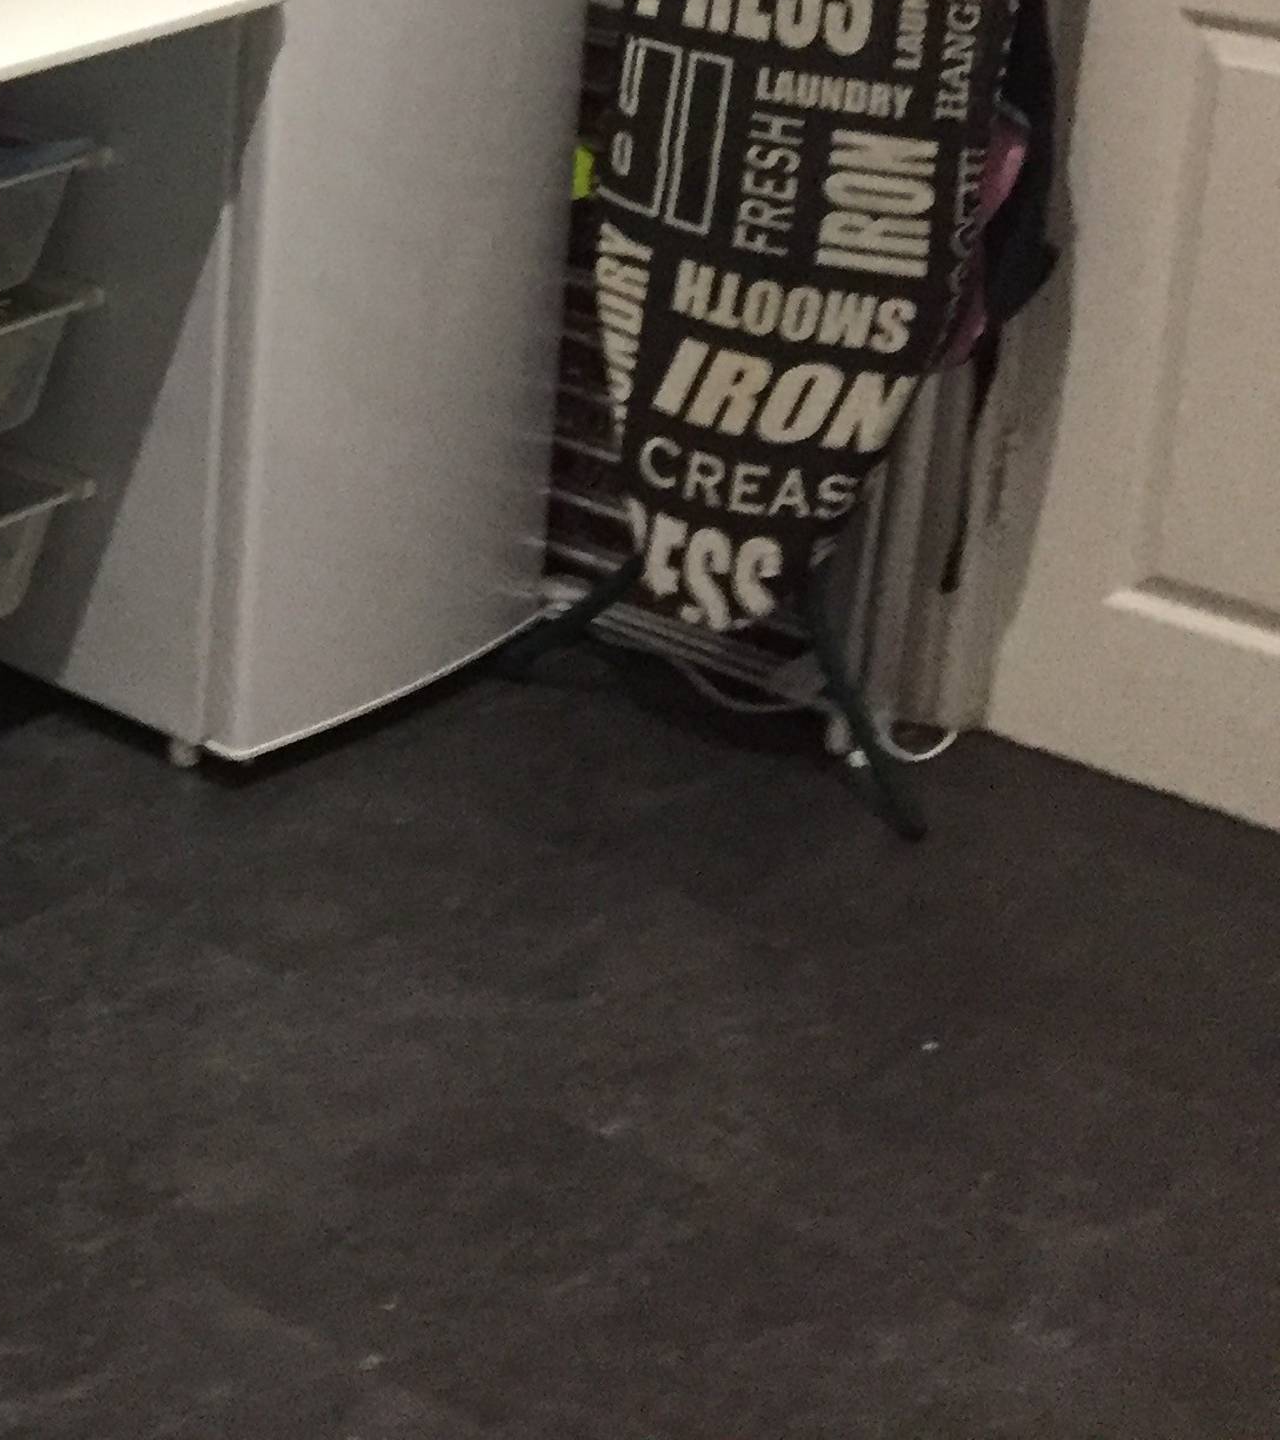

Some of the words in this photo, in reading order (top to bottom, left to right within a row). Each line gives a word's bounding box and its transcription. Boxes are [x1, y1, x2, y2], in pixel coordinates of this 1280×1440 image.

[756, 66, 914, 120] LAUNDRY
[733, 111, 806, 257] FRESH
[815, 128, 940, 278] IRON
[595, 221, 654, 432] UNDRY
[671, 258, 917, 353] SMOOTH
[651, 337, 919, 453] IRON
[640, 436, 860, 520] CREAS
[638, 510, 785, 632] ESS
